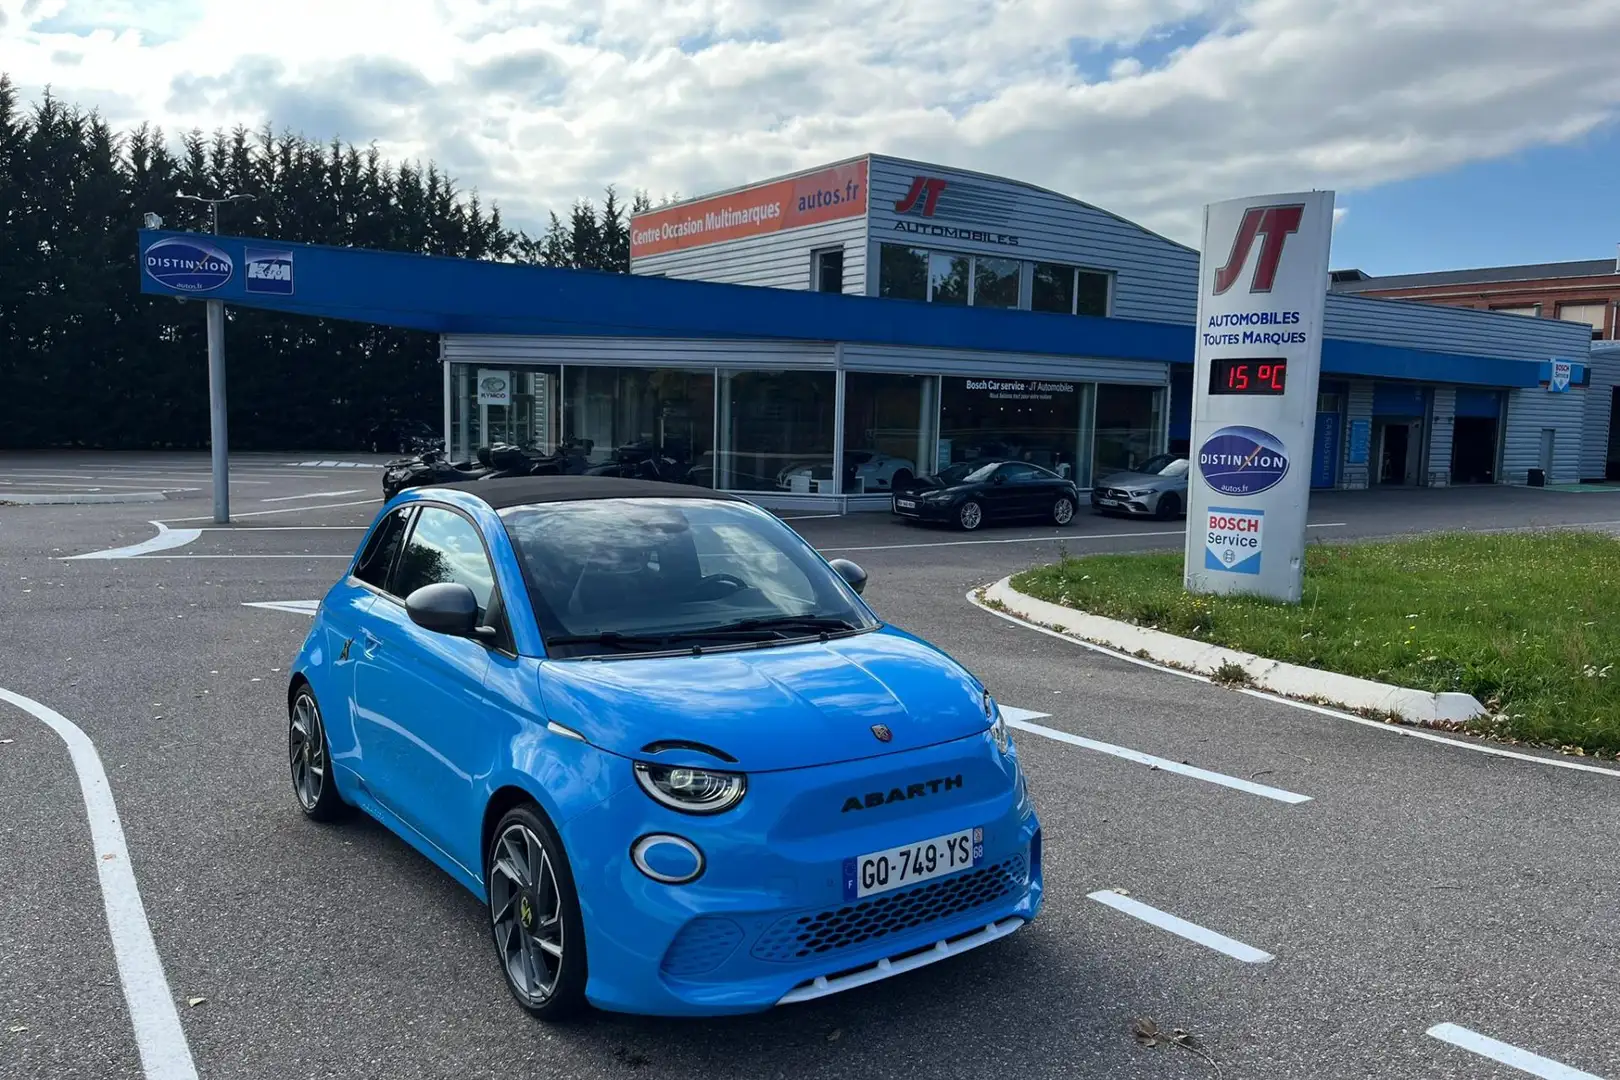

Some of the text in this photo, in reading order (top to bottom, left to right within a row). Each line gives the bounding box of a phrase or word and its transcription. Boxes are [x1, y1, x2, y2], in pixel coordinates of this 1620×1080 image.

[798, 179, 859, 212] autos.fr
[894, 175, 948, 217] JT
[632, 201, 781, 246] Centre Occasion Multimarques
[894, 221, 1019, 246] AUTOMOBILES
[1213, 203, 1305, 296] JT
[147, 256, 229, 272] DISTINXION
[1208, 311, 1300, 328] AUTOMOBILES
[1228, 365, 1248, 389] 15
[966, 380, 987, 390] Bosch
[988, 380, 1000, 390] Car
[1001, 381, 1025, 391] service
[1029, 382, 1037, 391] JT
[1037, 382, 1074, 392] Automobiles
[1200, 453, 1284, 468] DISTINXION
[1221, 484, 1249, 492] autos.fr
[1209, 516, 1259, 532] BOSCH
[1208, 532, 1258, 548] Service
[841, 774, 963, 813] ABARTH
[973, 845, 983, 859] 68
[862, 836, 970, 889] GQ-749-YS
[848, 880, 853, 890] F
